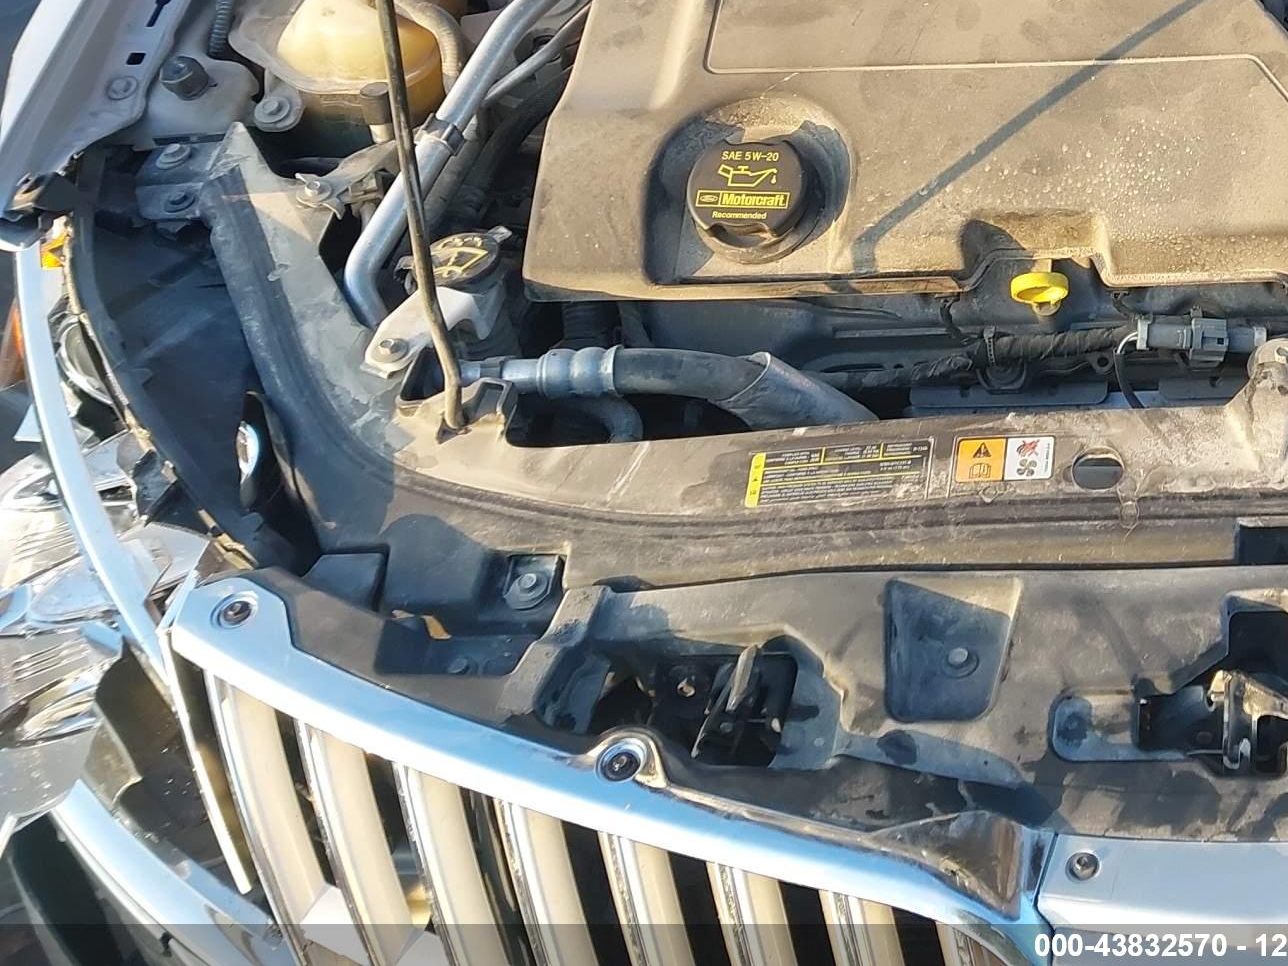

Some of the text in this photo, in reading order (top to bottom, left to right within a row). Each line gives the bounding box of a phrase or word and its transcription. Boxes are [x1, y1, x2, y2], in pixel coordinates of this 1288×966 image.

[721, 151, 779, 162] SAE 5W-20
[721, 193, 786, 206] Motorcraft
[712, 211, 767, 220] Recommended
